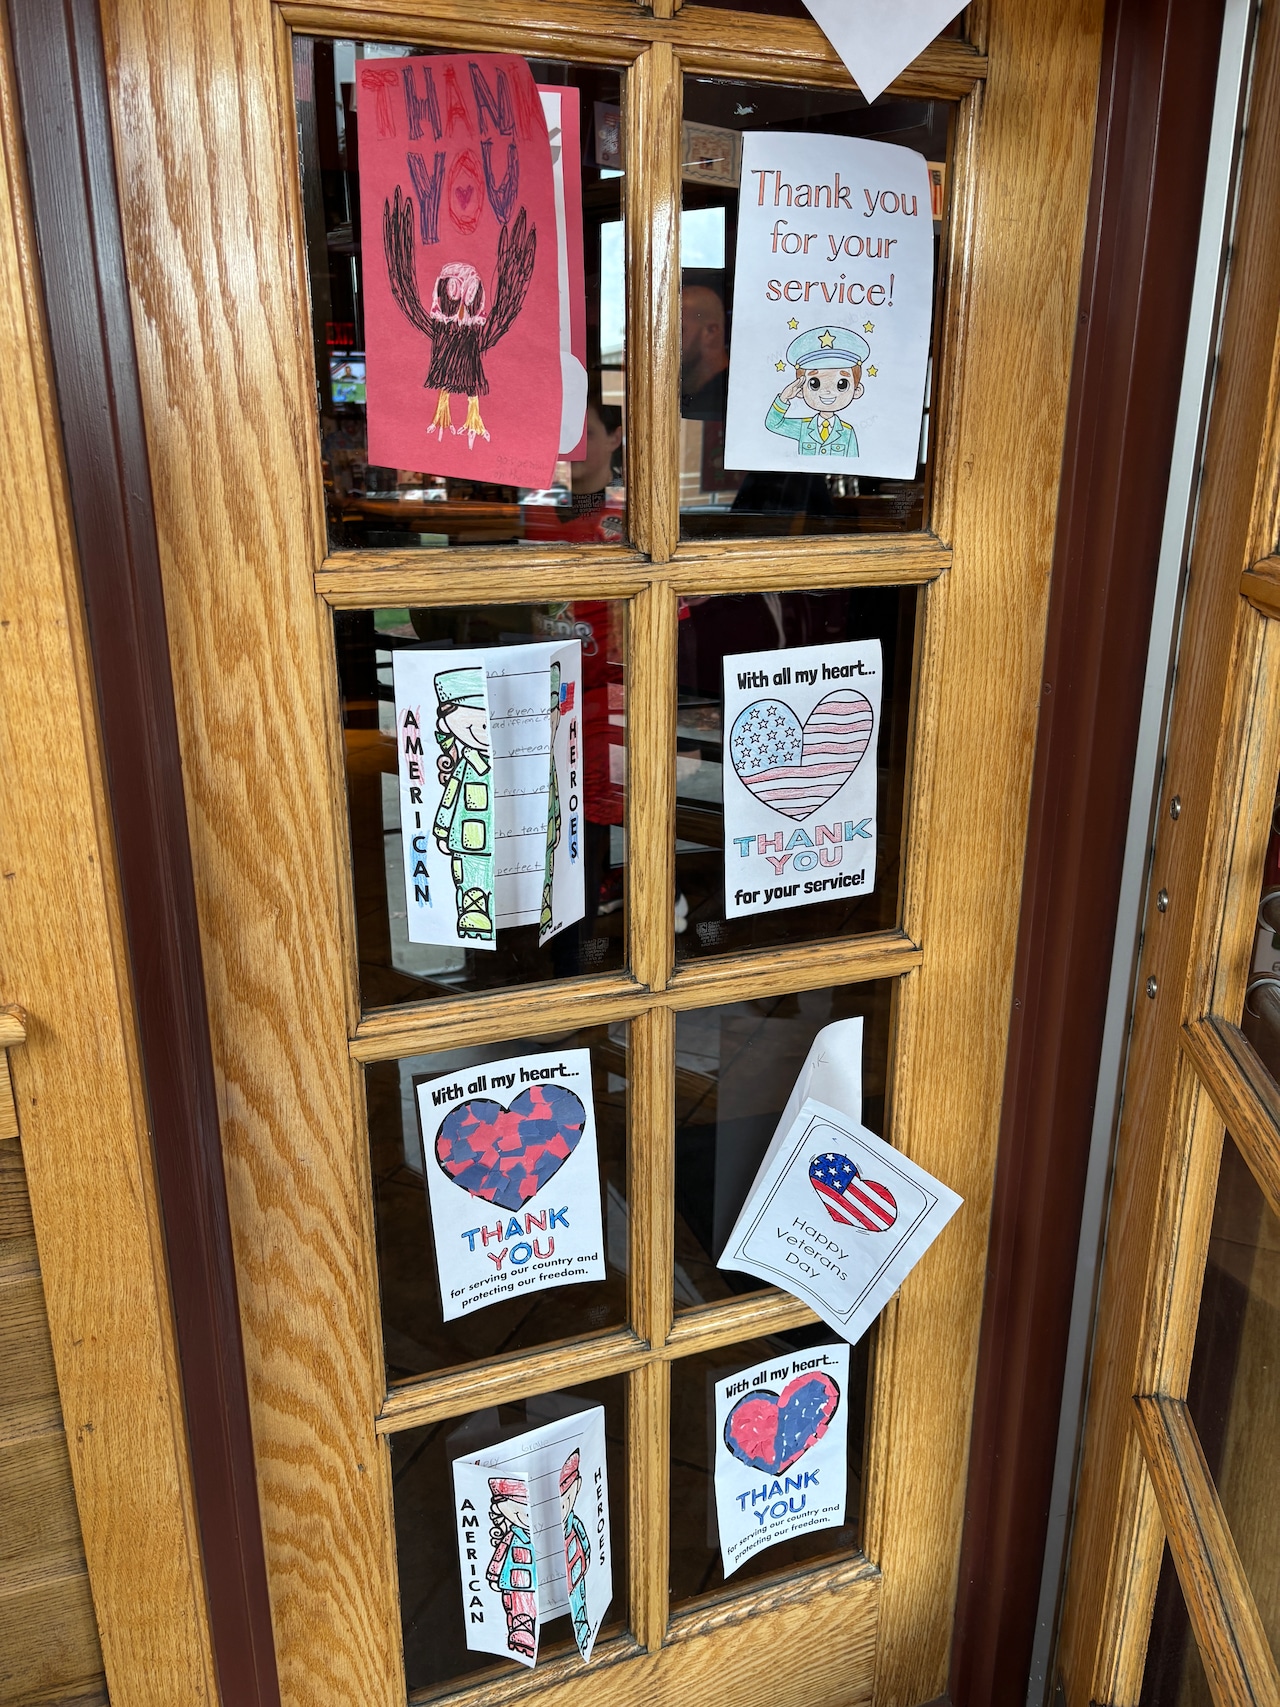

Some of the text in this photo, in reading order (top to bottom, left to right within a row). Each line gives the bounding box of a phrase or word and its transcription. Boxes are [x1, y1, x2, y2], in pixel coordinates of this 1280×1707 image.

[407, 136, 519, 246] YOU
[750, 168, 918, 218] Thank you
[770, 219, 898, 262] for your
[765, 273, 896, 307] service!
[737, 660, 876, 690] With all my heart...
[402, 709, 431, 903] AMERICAN
[568, 720, 579, 859] HEROES
[734, 818, 872, 857] THANK
[766, 846, 842, 876] YOU
[734, 869, 865, 906] for your service!
[431, 1063, 580, 1106] With all my heart...
[461, 1206, 569, 1251] THANK
[792, 1216, 849, 1260] Happy
[450, 1252, 599, 1299] for serving our country and
[487, 1236, 555, 1271] YOU
[775, 1227, 849, 1281] Veterans
[785, 1252, 821, 1279] Day
[461, 1268, 589, 1309] protecting our freedom.
[725, 1354, 839, 1399] With all my heart...
[736, 1468, 820, 1511] THANK
[753, 1494, 807, 1525] YOU
[594, 1467, 606, 1566] HEROES
[727, 1504, 840, 1555] for serving our country and
[460, 1498, 484, 1624] AMERICAN
[734, 1517, 831, 1564] protecting our freedom.
